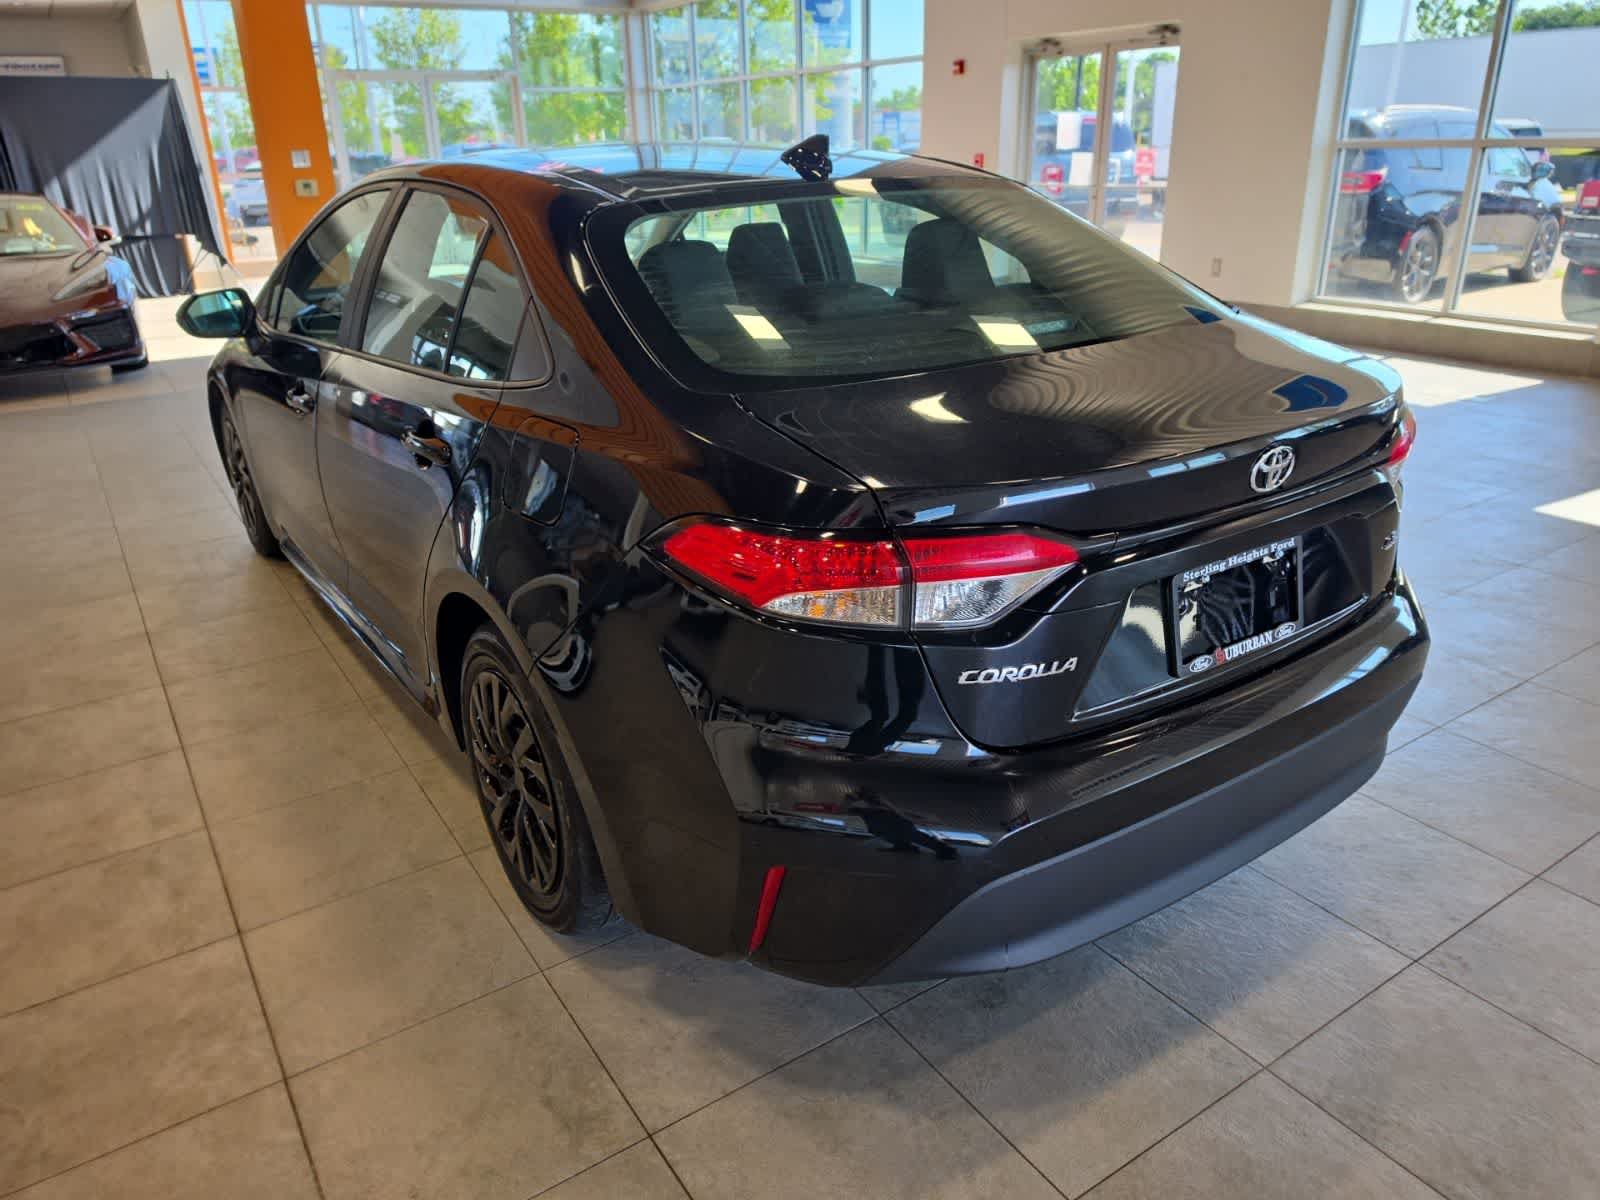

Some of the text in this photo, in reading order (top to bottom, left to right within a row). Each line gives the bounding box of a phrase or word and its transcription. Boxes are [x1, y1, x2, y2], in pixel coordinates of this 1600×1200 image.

[1183, 538, 1295, 582] Sterling Heights Ford
[1216, 631, 1273, 665] SUBURBAN
[958, 656, 1078, 684] COROLLA
